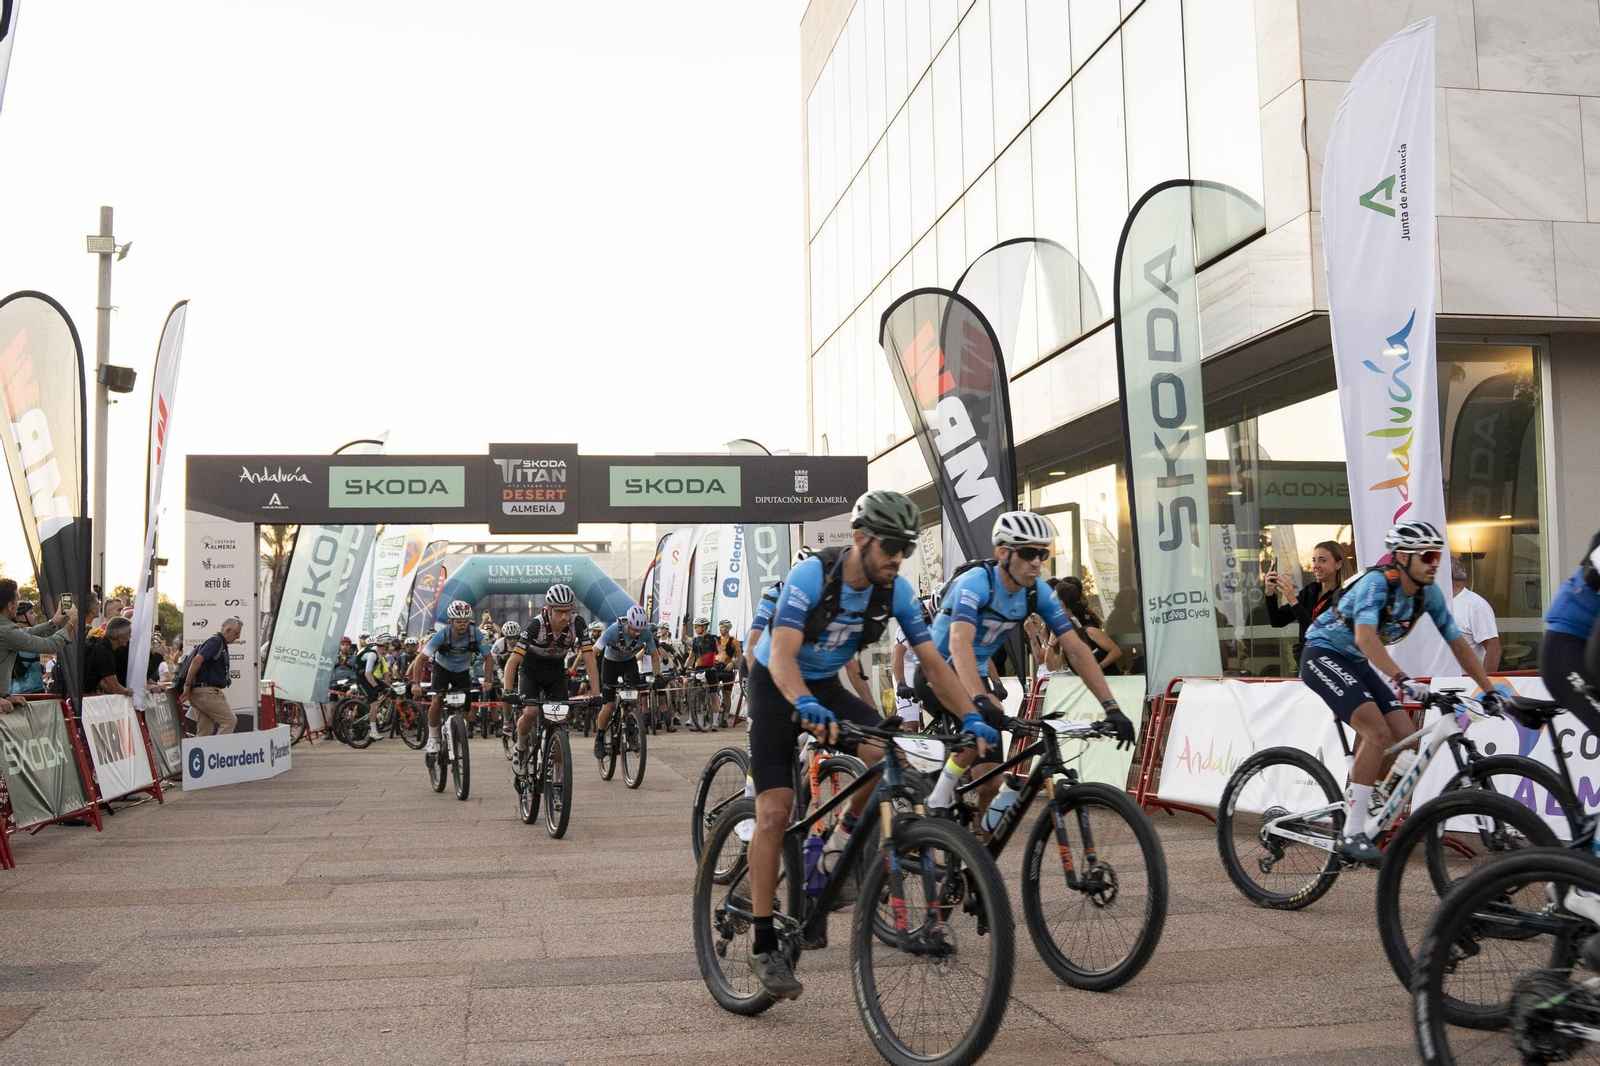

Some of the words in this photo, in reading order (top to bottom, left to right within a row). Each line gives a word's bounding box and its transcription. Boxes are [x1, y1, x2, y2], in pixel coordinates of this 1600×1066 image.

[1397, 143, 1408, 194] Andalucía
[1399, 196, 1408, 209] de
[1401, 211, 1411, 241] Junta
[1143, 244, 1204, 551] SKODA
[493, 459, 567, 484] TITAN
[522, 460, 567, 468] SKODA
[239, 465, 313, 484] Andalucía
[344, 479, 450, 495] SKODA
[625, 478, 726, 494] SKODA
[502, 489, 567, 501] DESERT
[755, 495, 802, 504] DIPUTACIÓN
[803, 496, 814, 504] DE
[815, 495, 848, 504] ALMERÍA
[510, 503, 557, 513] ALMERÍA
[487, 564, 573, 576] UNIVERSAE
[488, 576, 518, 585] Instituto
[519, 576, 550, 587] Superior
[551, 576, 562, 584] de
[562, 576, 573, 584] FP
[90, 716, 136, 767] MRW
[207, 747, 265, 770] Cleardent
